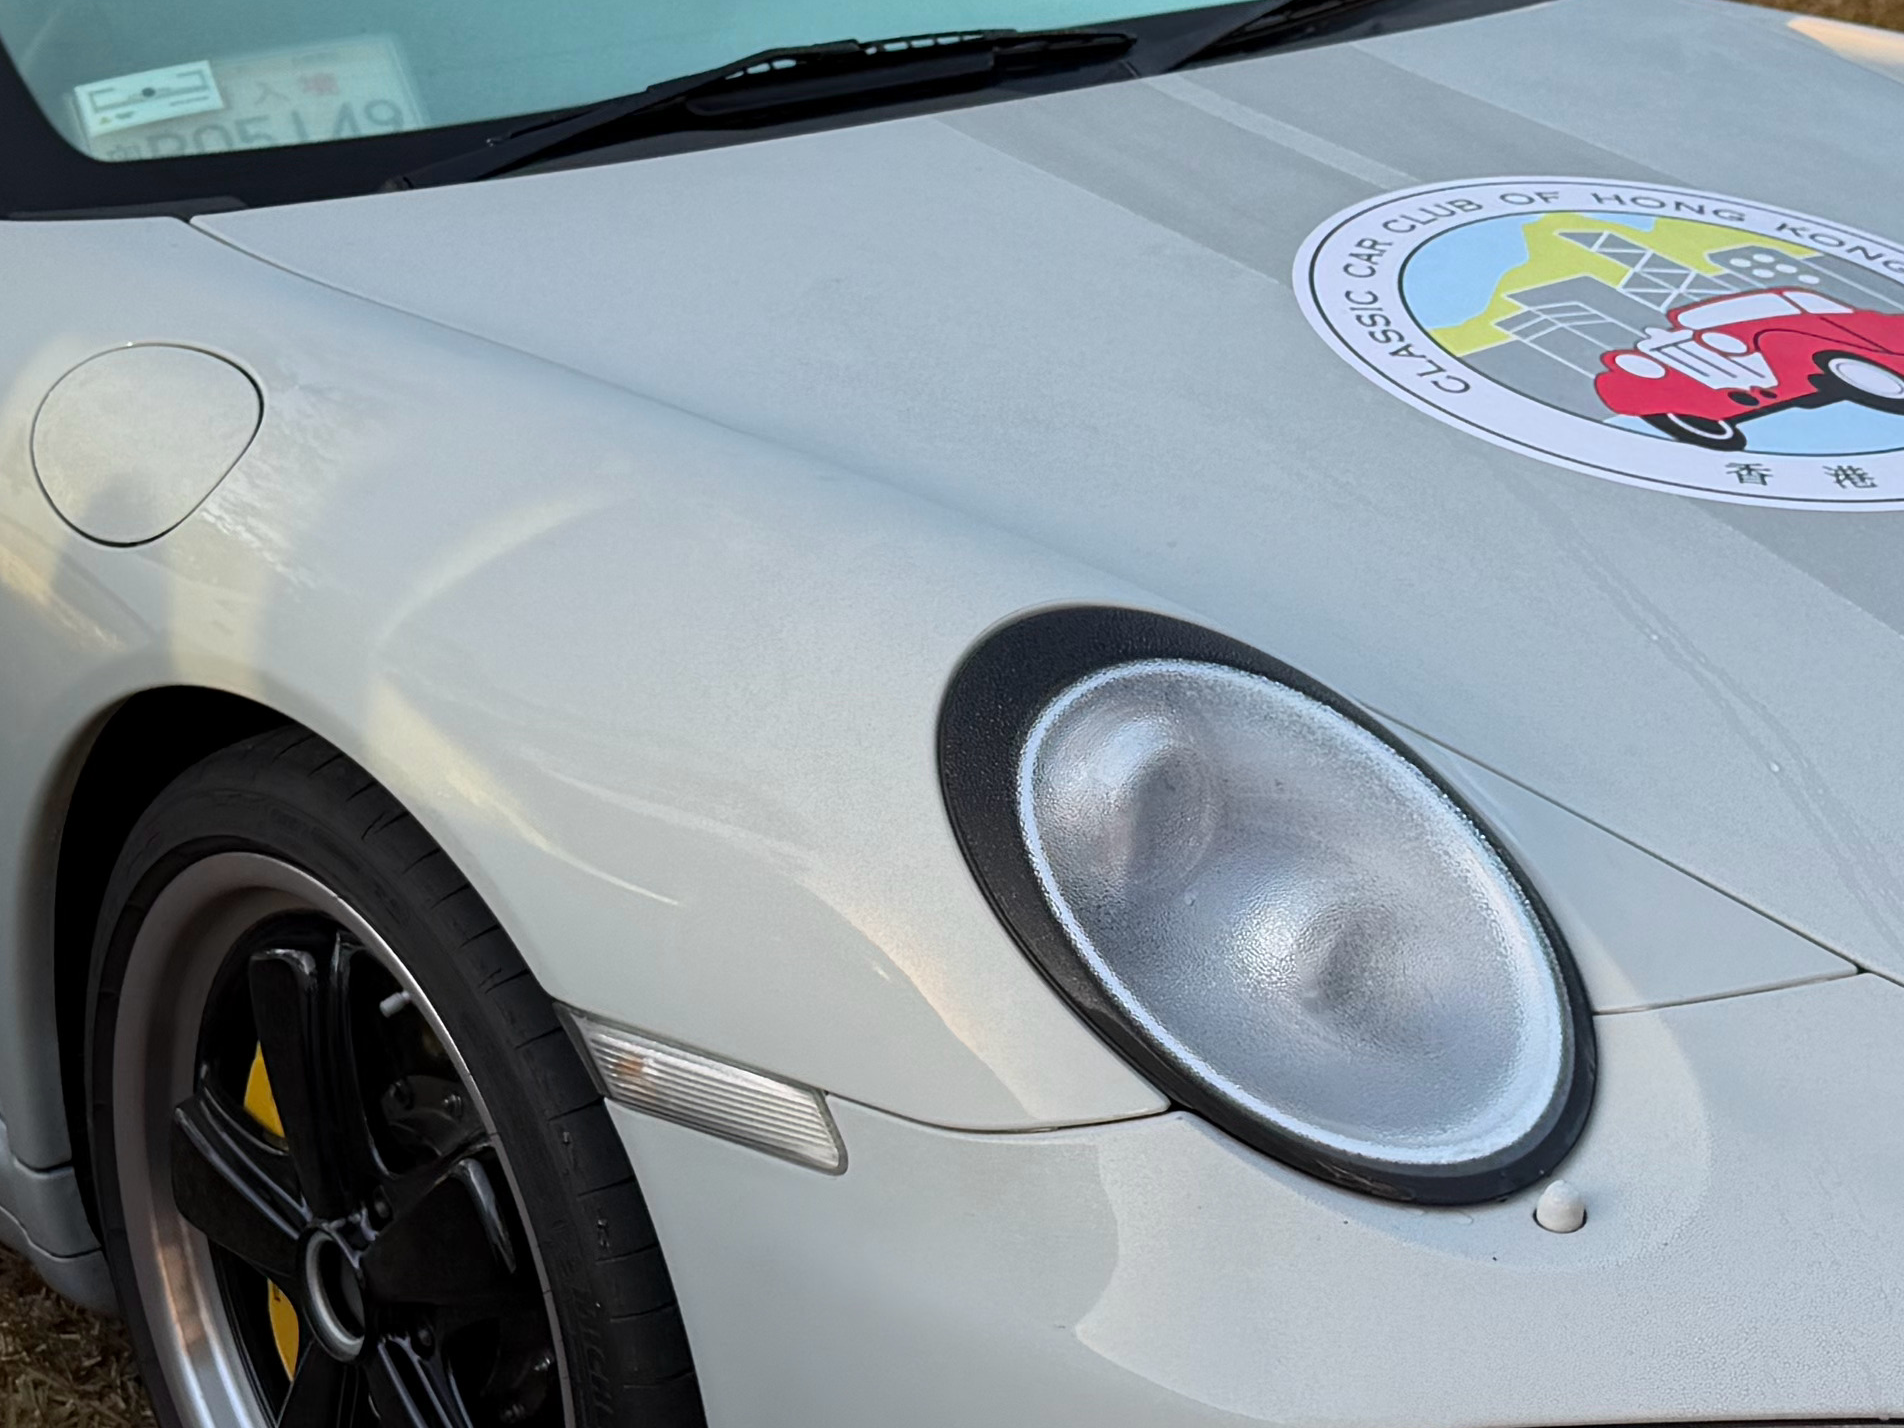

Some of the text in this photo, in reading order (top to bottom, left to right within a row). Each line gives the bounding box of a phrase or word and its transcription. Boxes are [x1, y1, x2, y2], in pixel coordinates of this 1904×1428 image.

[1382, 198, 1484, 234] CLUB
[1499, 191, 1560, 206] OF
[1590, 192, 1747, 222] HONG
[1342, 237, 1394, 278] CAR
[1344, 289, 1471, 394] CLASSIC
